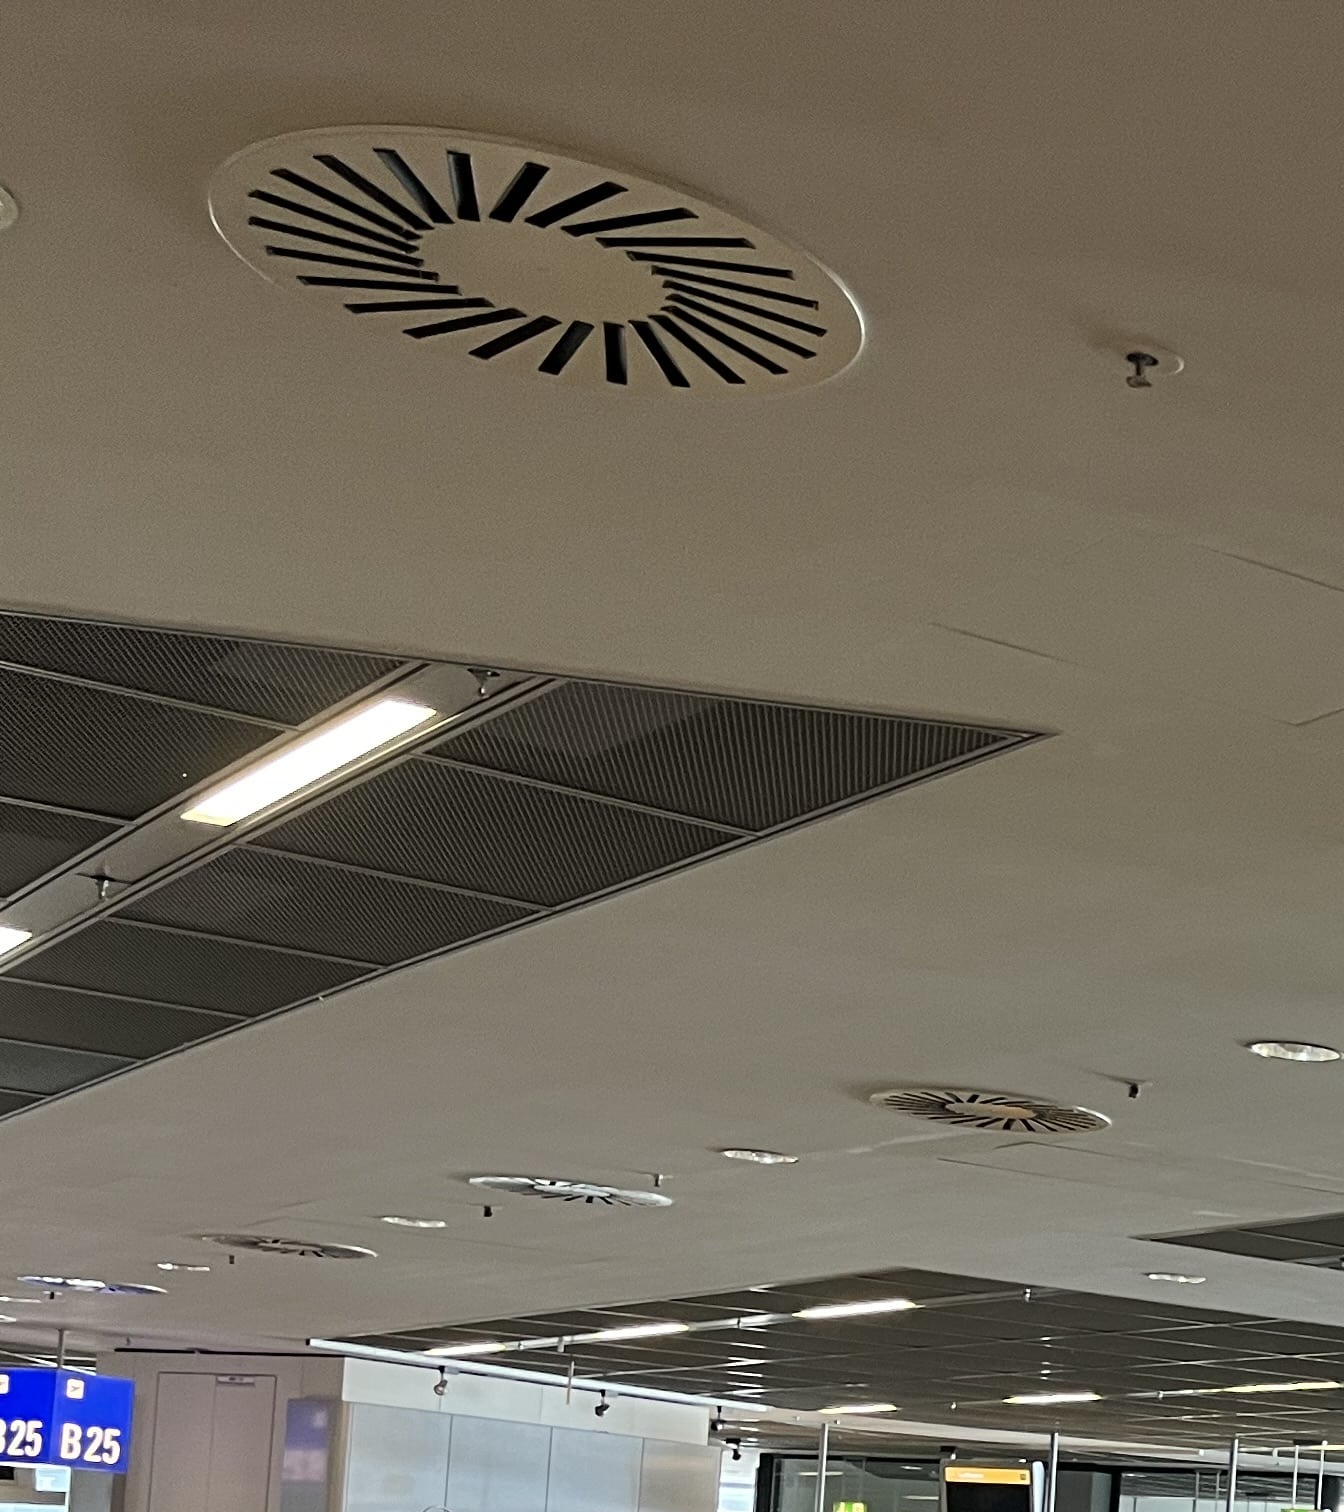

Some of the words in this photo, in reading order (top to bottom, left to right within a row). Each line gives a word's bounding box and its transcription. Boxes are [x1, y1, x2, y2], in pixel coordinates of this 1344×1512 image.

[7, 1419, 43, 1458] 25
[60, 1422, 82, 1460] B
[83, 1425, 121, 1465] 25
